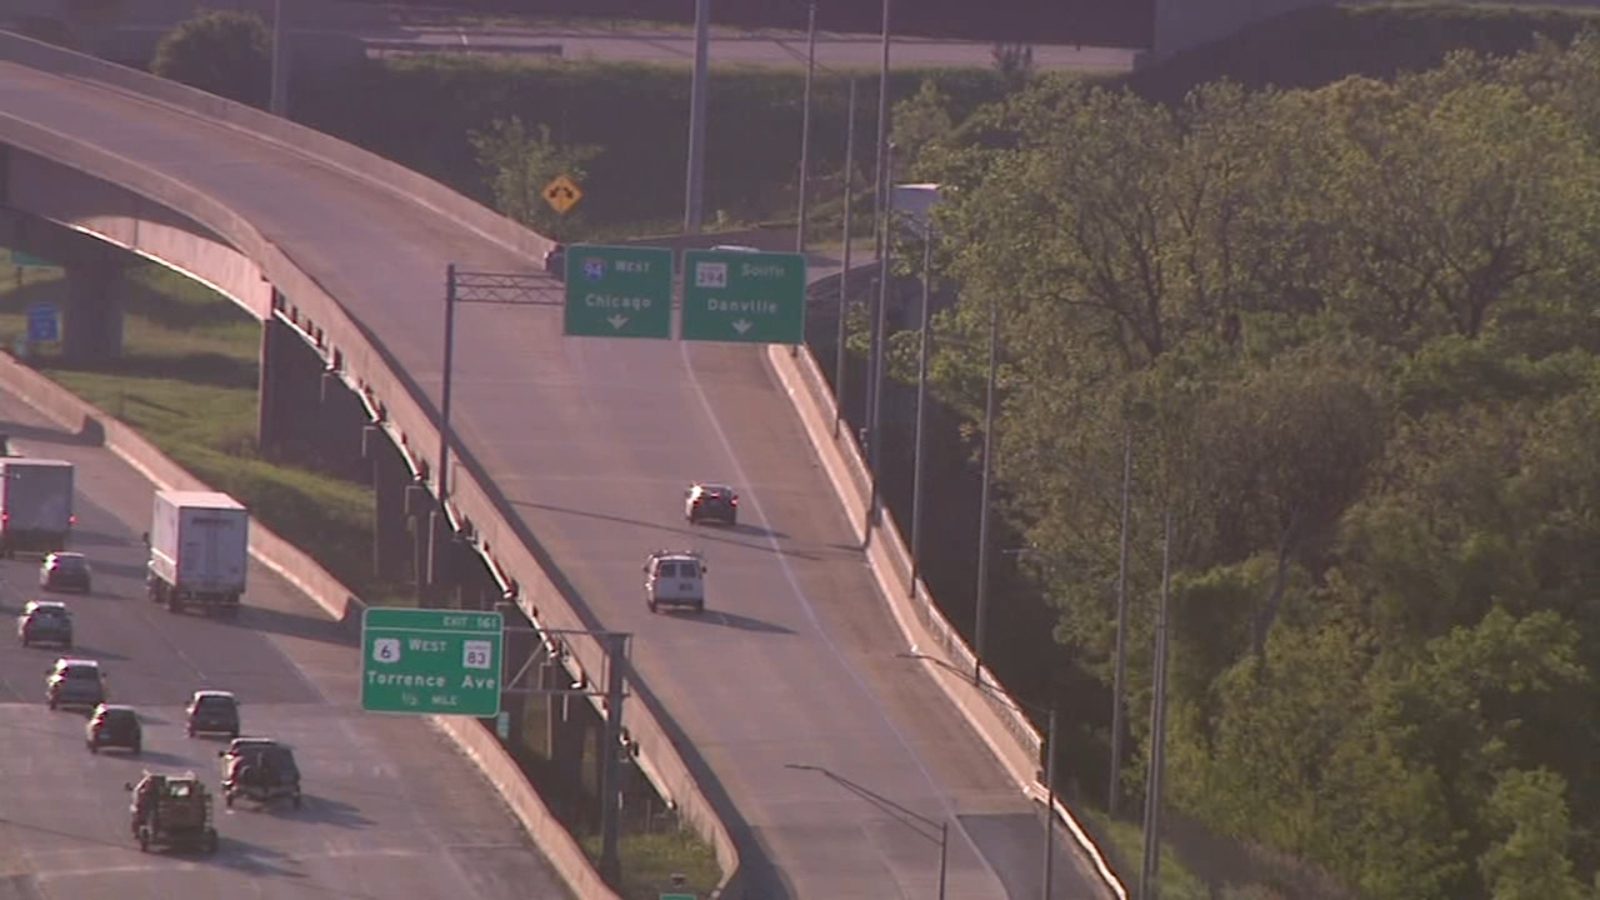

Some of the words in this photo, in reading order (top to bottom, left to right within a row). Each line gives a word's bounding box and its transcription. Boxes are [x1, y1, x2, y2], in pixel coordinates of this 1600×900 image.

[585, 294, 652, 311] Chicago
[707, 299, 778, 314] Danville
[443, 616, 468, 627] EXIT
[380, 645, 391, 659] 6
[408, 638, 447, 652] WEST
[467, 651, 486, 665] 83
[367, 670, 446, 688] Torrence
[461, 675, 496, 690] Ave
[431, 695, 459, 706] MILE
